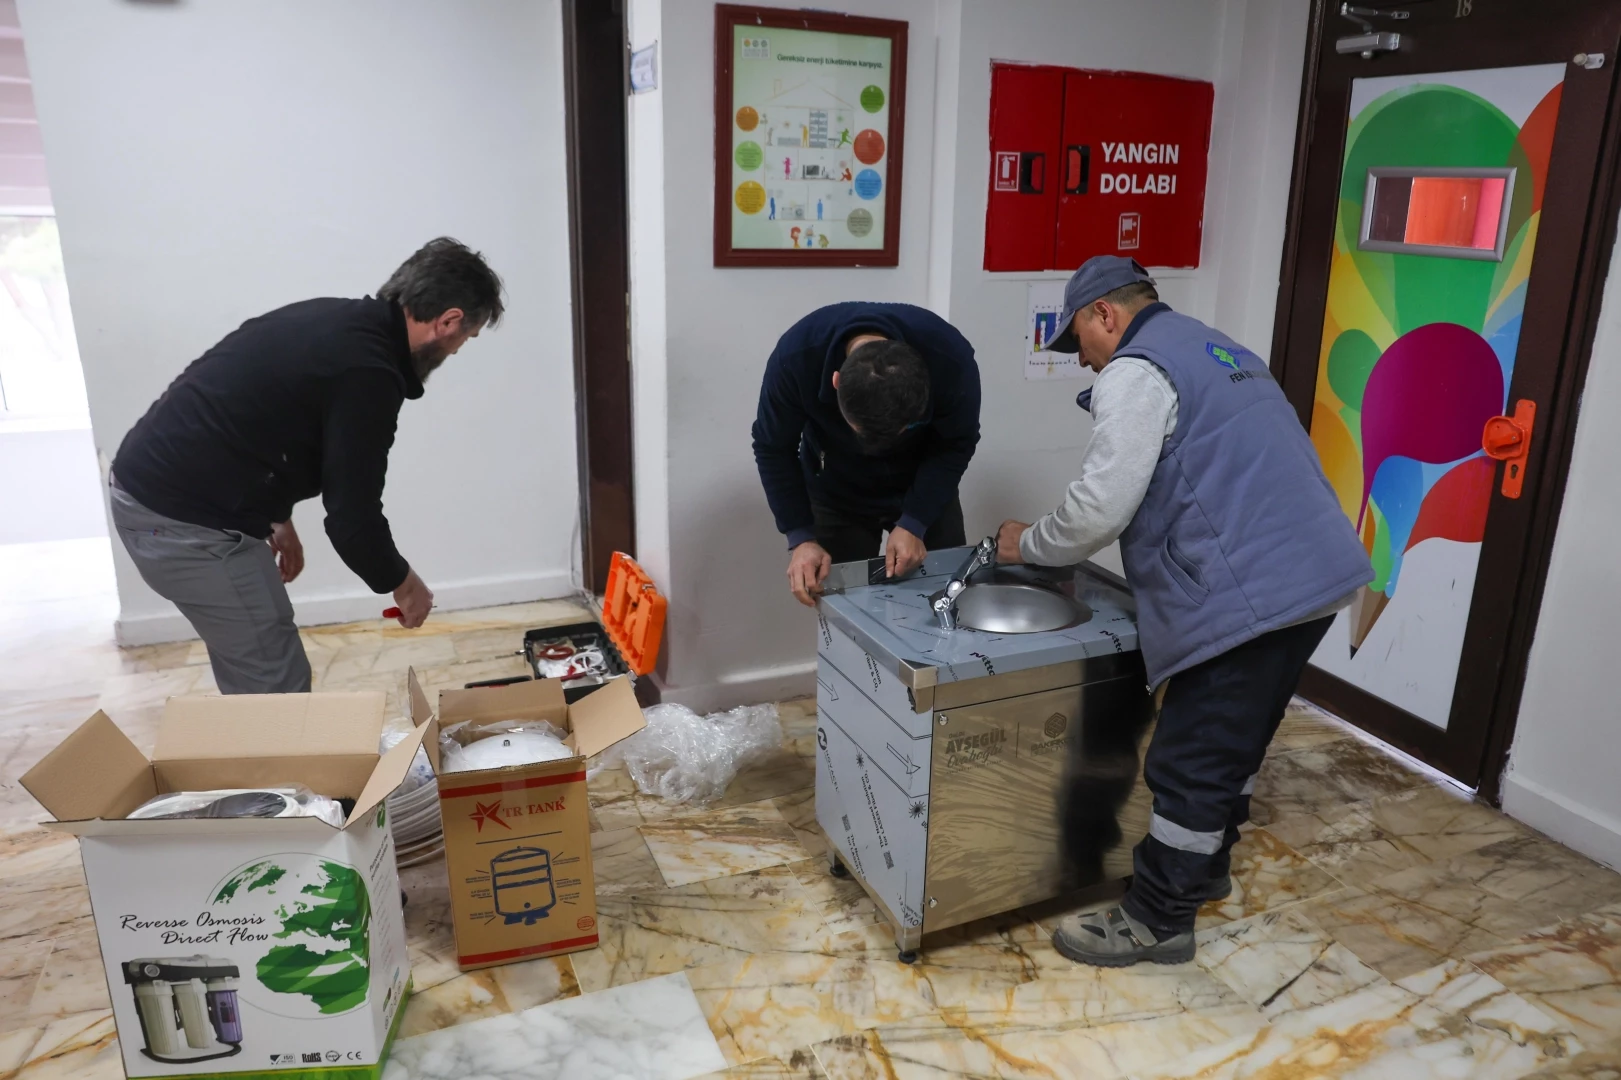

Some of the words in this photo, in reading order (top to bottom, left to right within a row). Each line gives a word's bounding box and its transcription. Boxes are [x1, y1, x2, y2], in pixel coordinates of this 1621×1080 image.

[777, 54, 805, 63] Gereksiz
[806, 57, 824, 66] enerji
[1101, 142, 1180, 164] YANGIN
[1100, 173, 1177, 195] DOLABI
[1229, 371, 1246, 384] FEN
[969, 652, 995, 676] Nitto
[502, 807, 523, 818] TR
[526, 800, 566, 815] TANK
[120, 914, 188, 932] Reverse
[196, 912, 266, 927] Osmosis
[161, 930, 222, 946] Direct
[226, 927, 268, 945] Flow
[347, 1051, 362, 1060] CE
